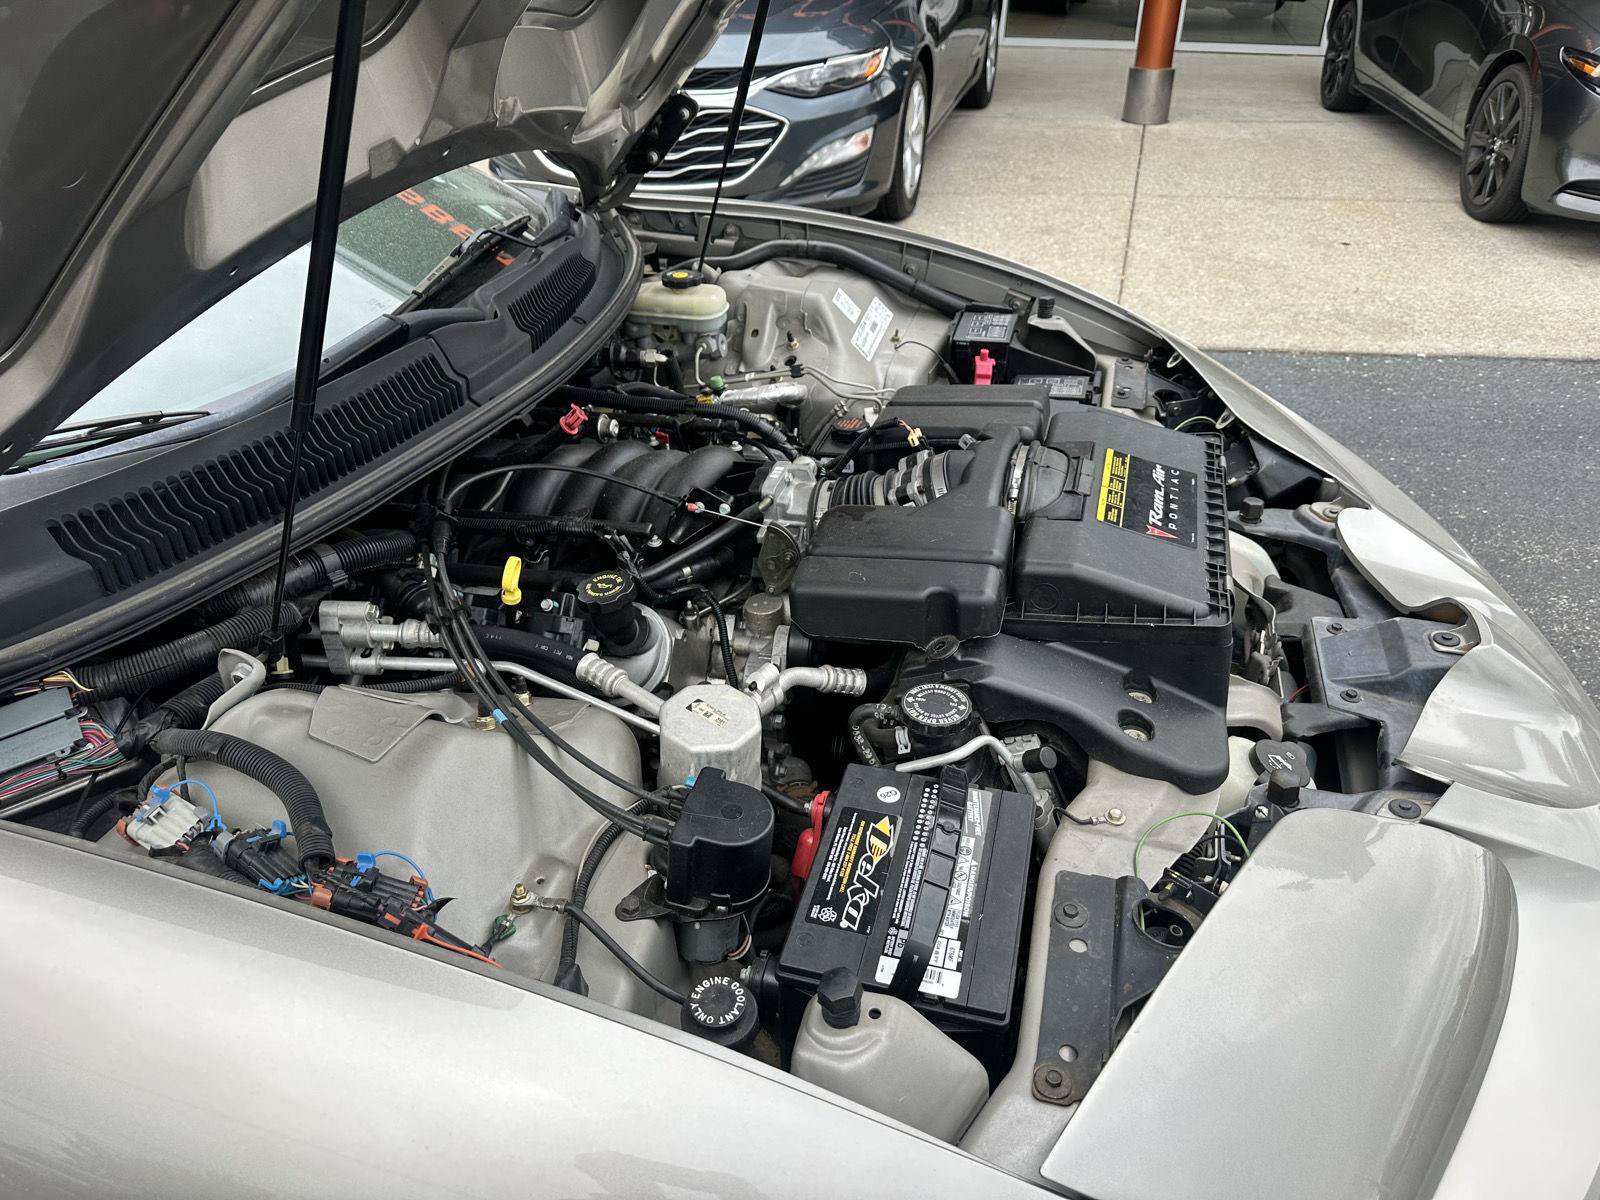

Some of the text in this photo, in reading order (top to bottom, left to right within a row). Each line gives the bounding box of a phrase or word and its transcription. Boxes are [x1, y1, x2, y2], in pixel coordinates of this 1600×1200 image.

[1149, 463, 1166, 527] Ram Air
[1168, 469, 1180, 531] PONTIAC
[907, 707, 961, 724] NEVER OPEN HOT
[897, 938, 907, 948] Pb
[690, 976, 746, 1025] ENGINE COOLANT ONLY
